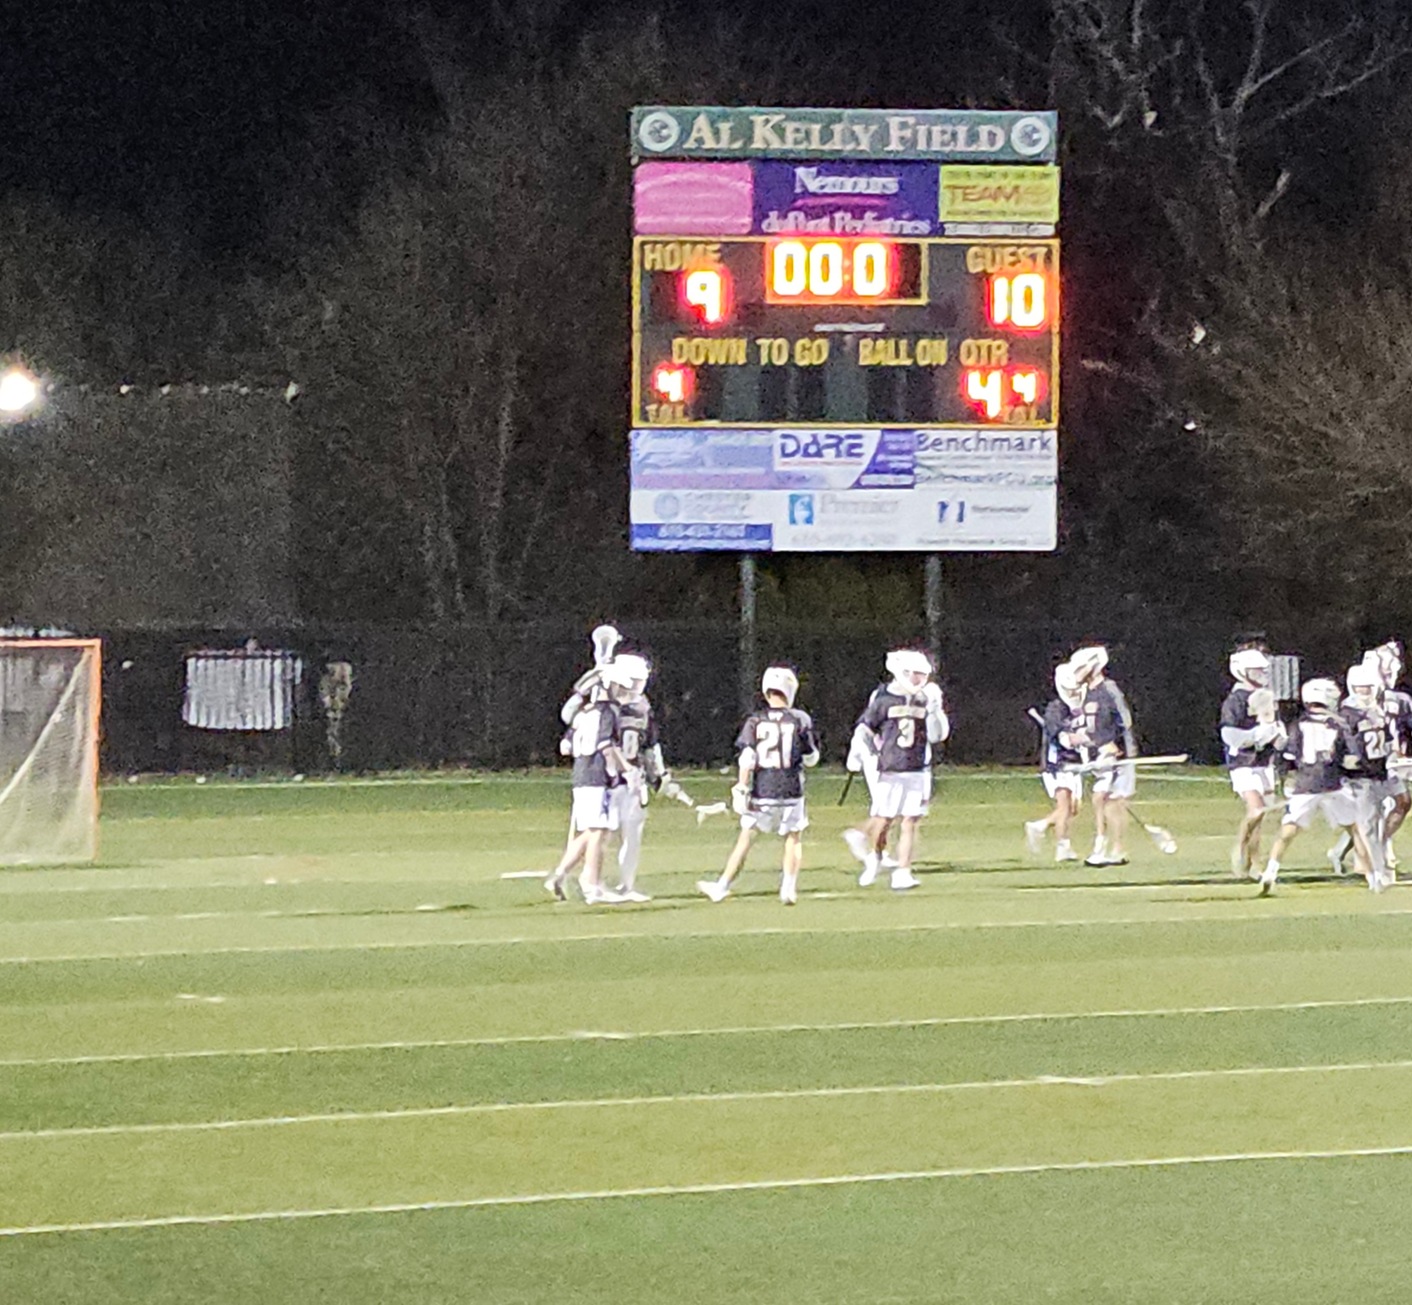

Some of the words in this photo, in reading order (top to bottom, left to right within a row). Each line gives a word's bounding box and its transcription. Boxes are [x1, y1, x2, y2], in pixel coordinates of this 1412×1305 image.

[683, 113, 743, 149] AL
[750, 114, 878, 152] KELLY
[884, 116, 1006, 152] FIELD
[644, 243, 721, 271] HOME
[966, 246, 1048, 273] GUEST
[686, 271, 721, 323] 9
[993, 273, 1045, 326] 10
[672, 338, 747, 365] DOWN
[755, 338, 789, 366] TO
[795, 338, 829, 367] GO
[859, 338, 913, 366] BALL
[916, 338, 948, 366] ON
[967, 370, 1002, 418] 4
[915, 431, 1051, 452] Benchmark
[755, 721, 794, 769] 21
[897, 718, 915, 748] 3
